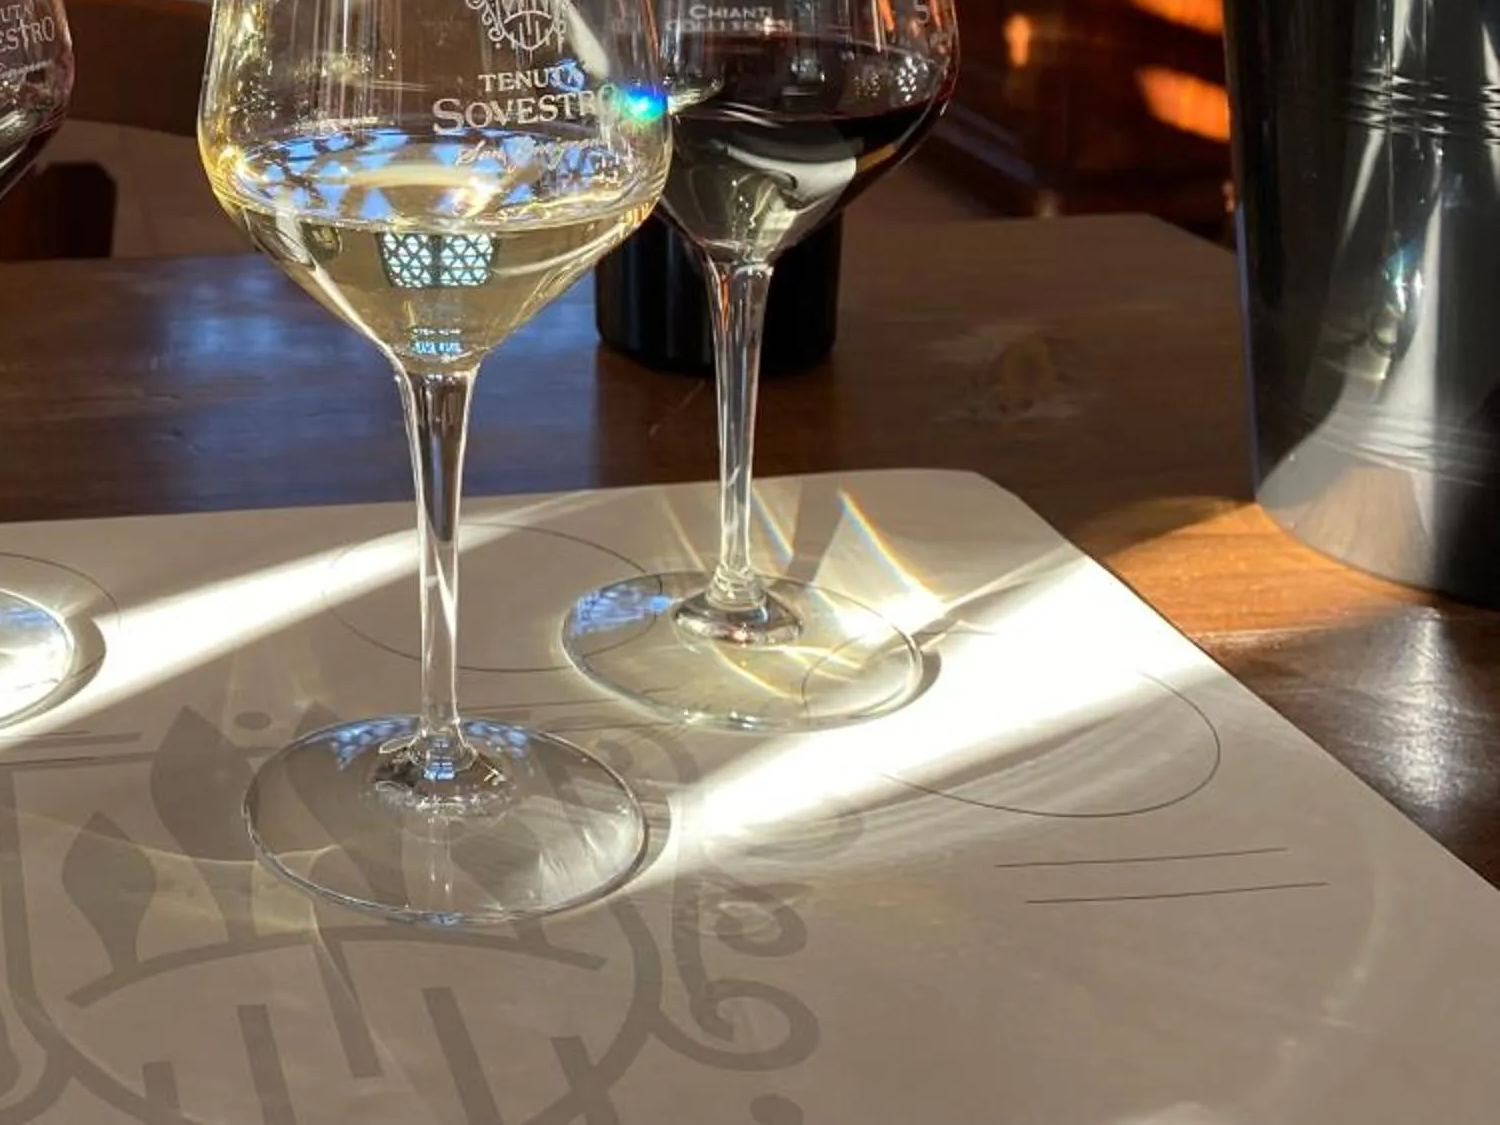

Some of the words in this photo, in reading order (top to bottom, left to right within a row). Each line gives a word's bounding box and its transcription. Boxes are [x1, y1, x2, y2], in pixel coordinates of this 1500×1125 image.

[689, 4, 773, 21] CHIANTI
[477, 65, 584, 93] TENUTA
[431, 82, 621, 136] SOVESTRO
